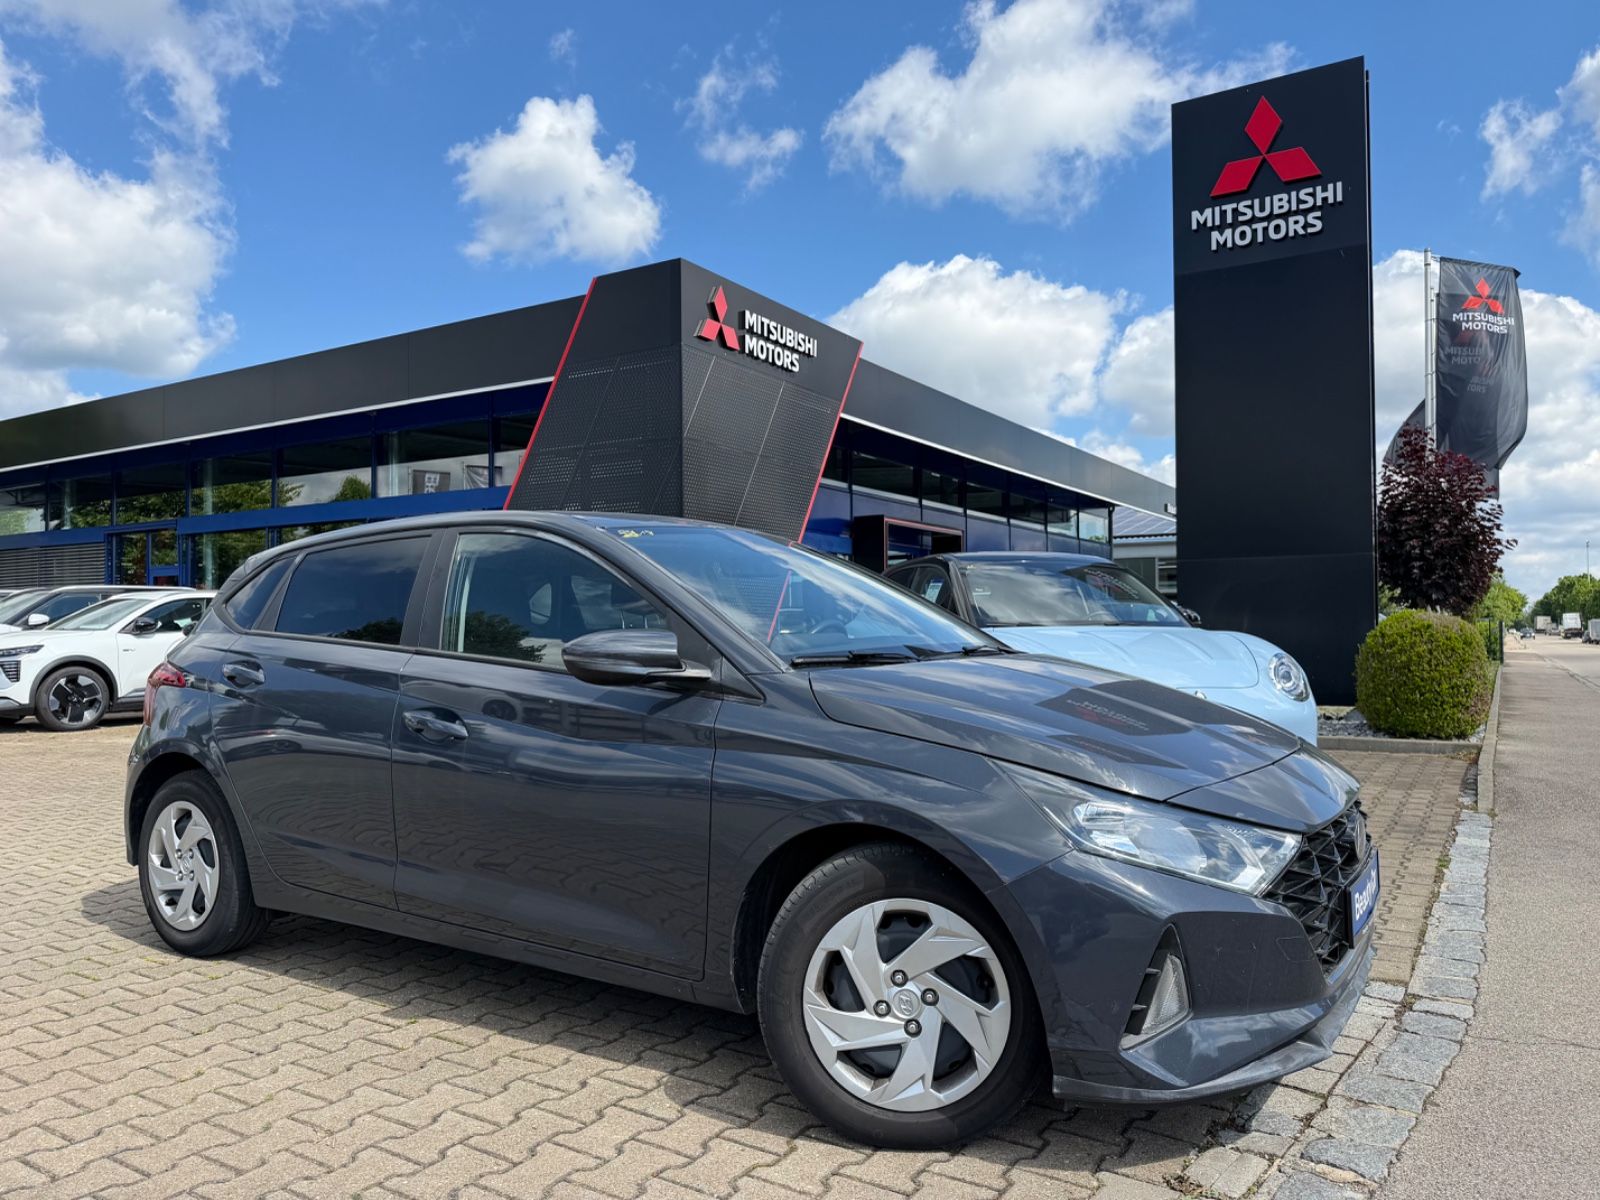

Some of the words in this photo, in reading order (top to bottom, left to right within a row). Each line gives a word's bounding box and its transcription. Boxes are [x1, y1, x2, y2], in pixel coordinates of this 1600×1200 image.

[1191, 181, 1343, 231] MITSUBISHI
[1210, 211, 1323, 251] MOTORS
[745, 310, 818, 357] MITSUBISHI
[1453, 312, 1515, 326] MITSUBISHI
[1462, 321, 1508, 333] MOTORS
[745, 335, 800, 372] MOTORS
[1451, 356, 1481, 365] MOTO
